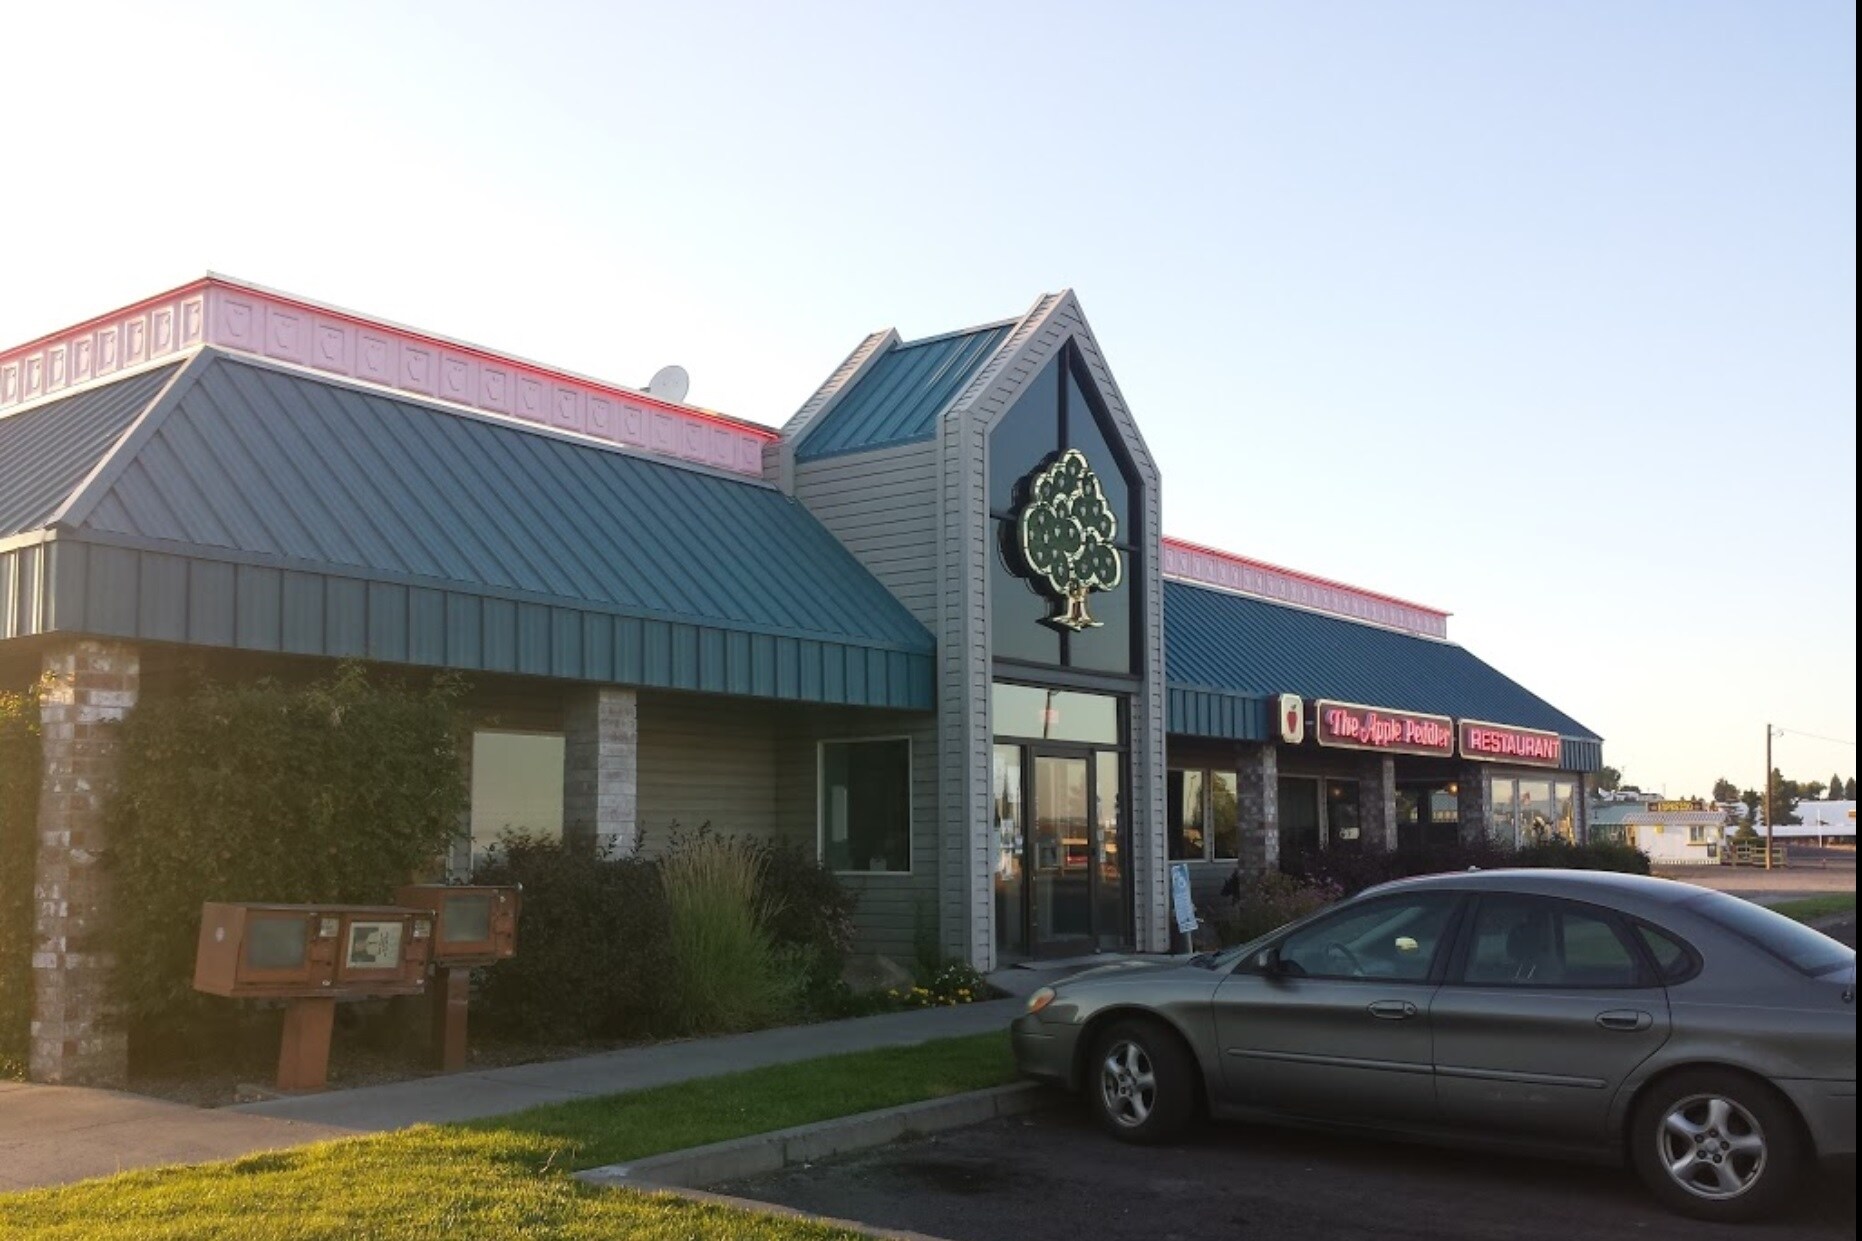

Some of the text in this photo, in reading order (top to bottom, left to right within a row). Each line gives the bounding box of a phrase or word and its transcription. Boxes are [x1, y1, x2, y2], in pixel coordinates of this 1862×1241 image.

[1326, 709, 1450, 747] The Apple Peddler
[1468, 729, 1560, 759] RESTAURANT
